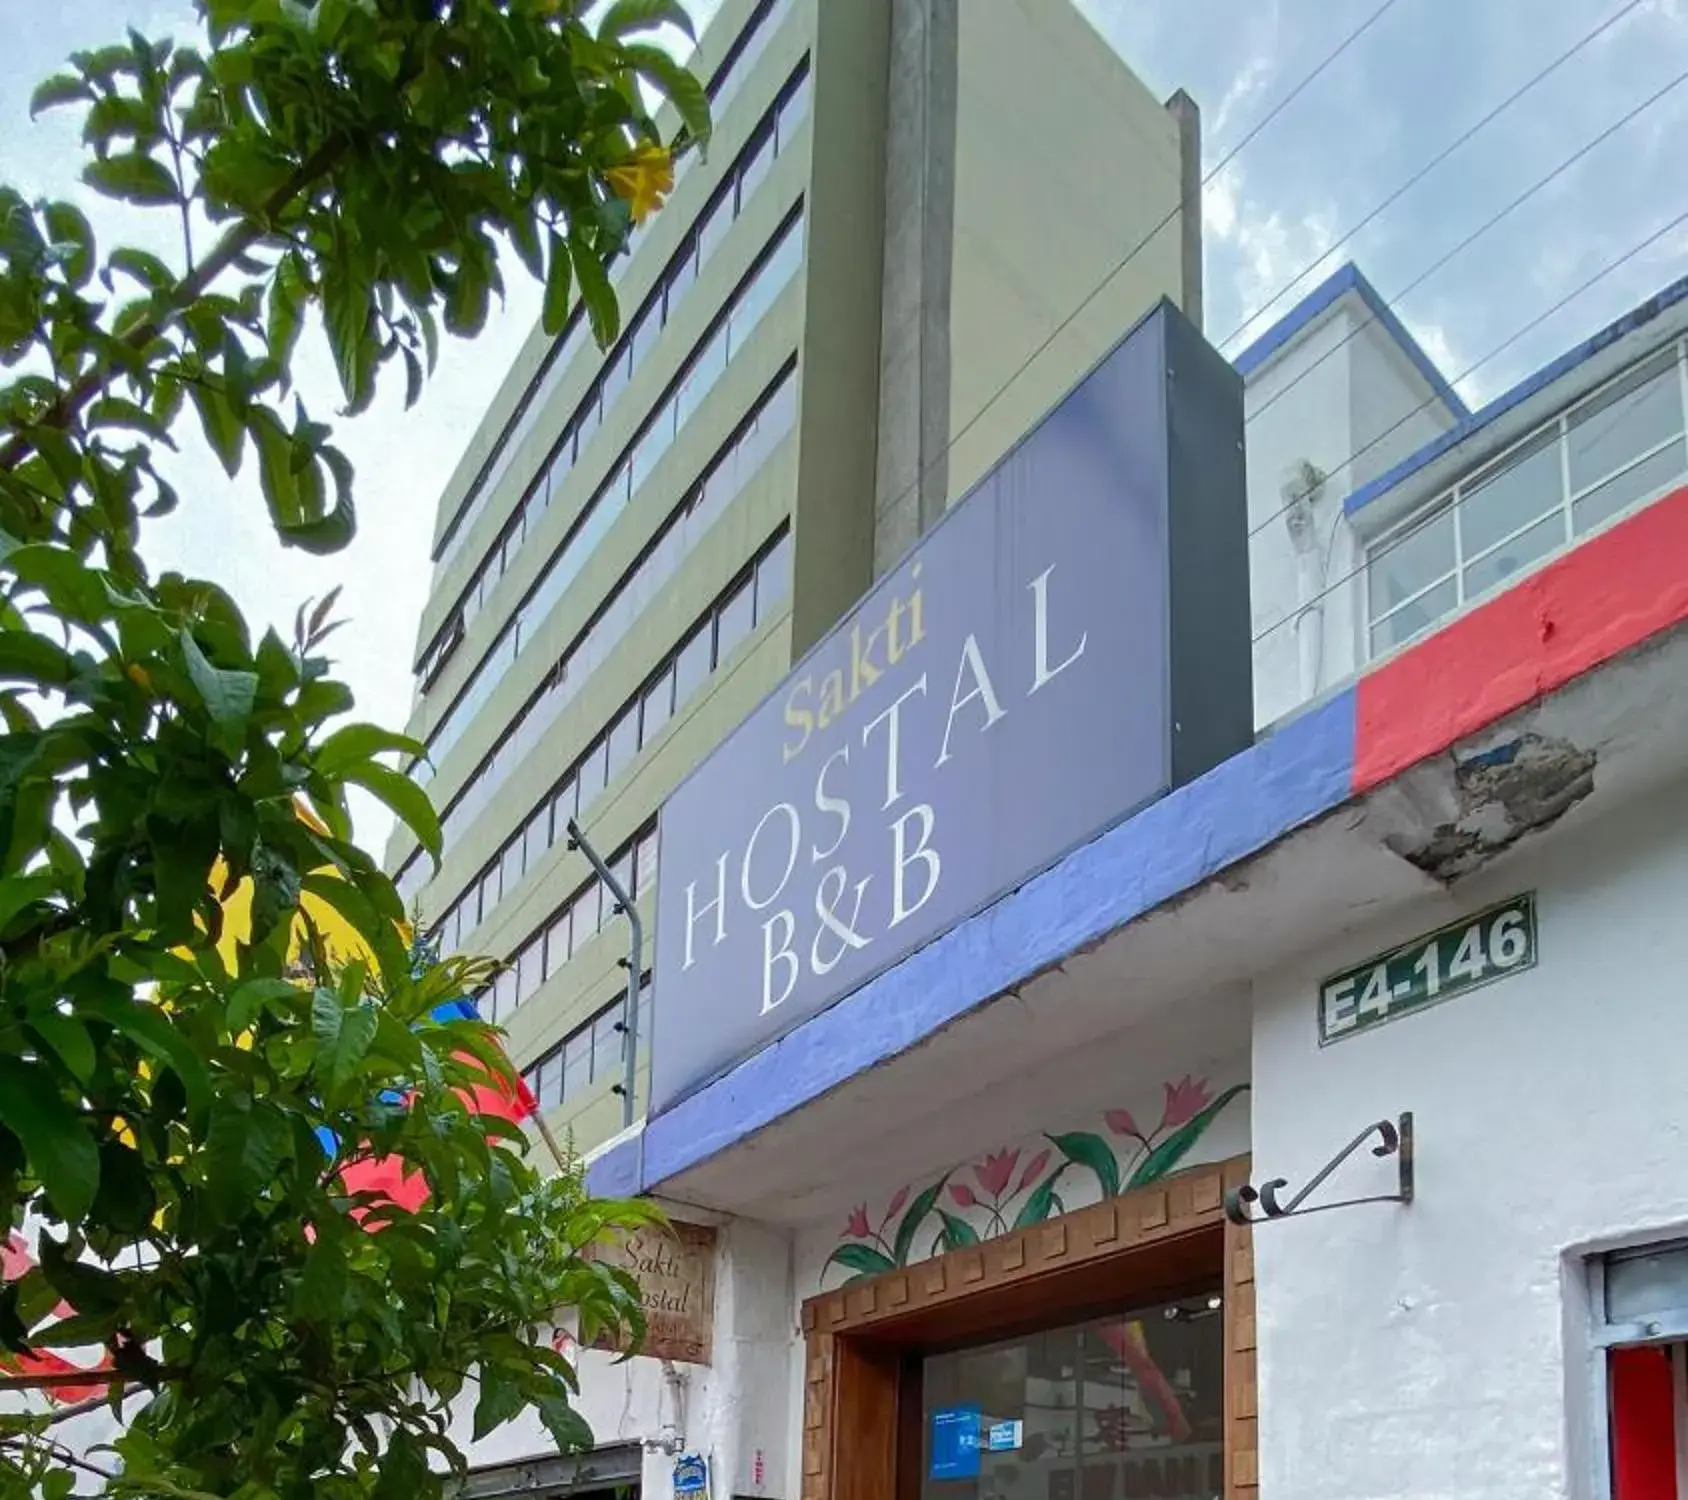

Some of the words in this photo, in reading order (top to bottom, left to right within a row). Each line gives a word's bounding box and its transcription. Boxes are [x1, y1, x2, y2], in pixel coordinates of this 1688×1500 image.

[782, 563, 925, 765] Sakti
[682, 563, 1087, 971] HOSTAL
[758, 803, 941, 1016] B&B
[1325, 909, 1527, 1036] E4-146
[619, 1238, 680, 1278] Sakti
[636, 1274, 690, 1312] ostal
